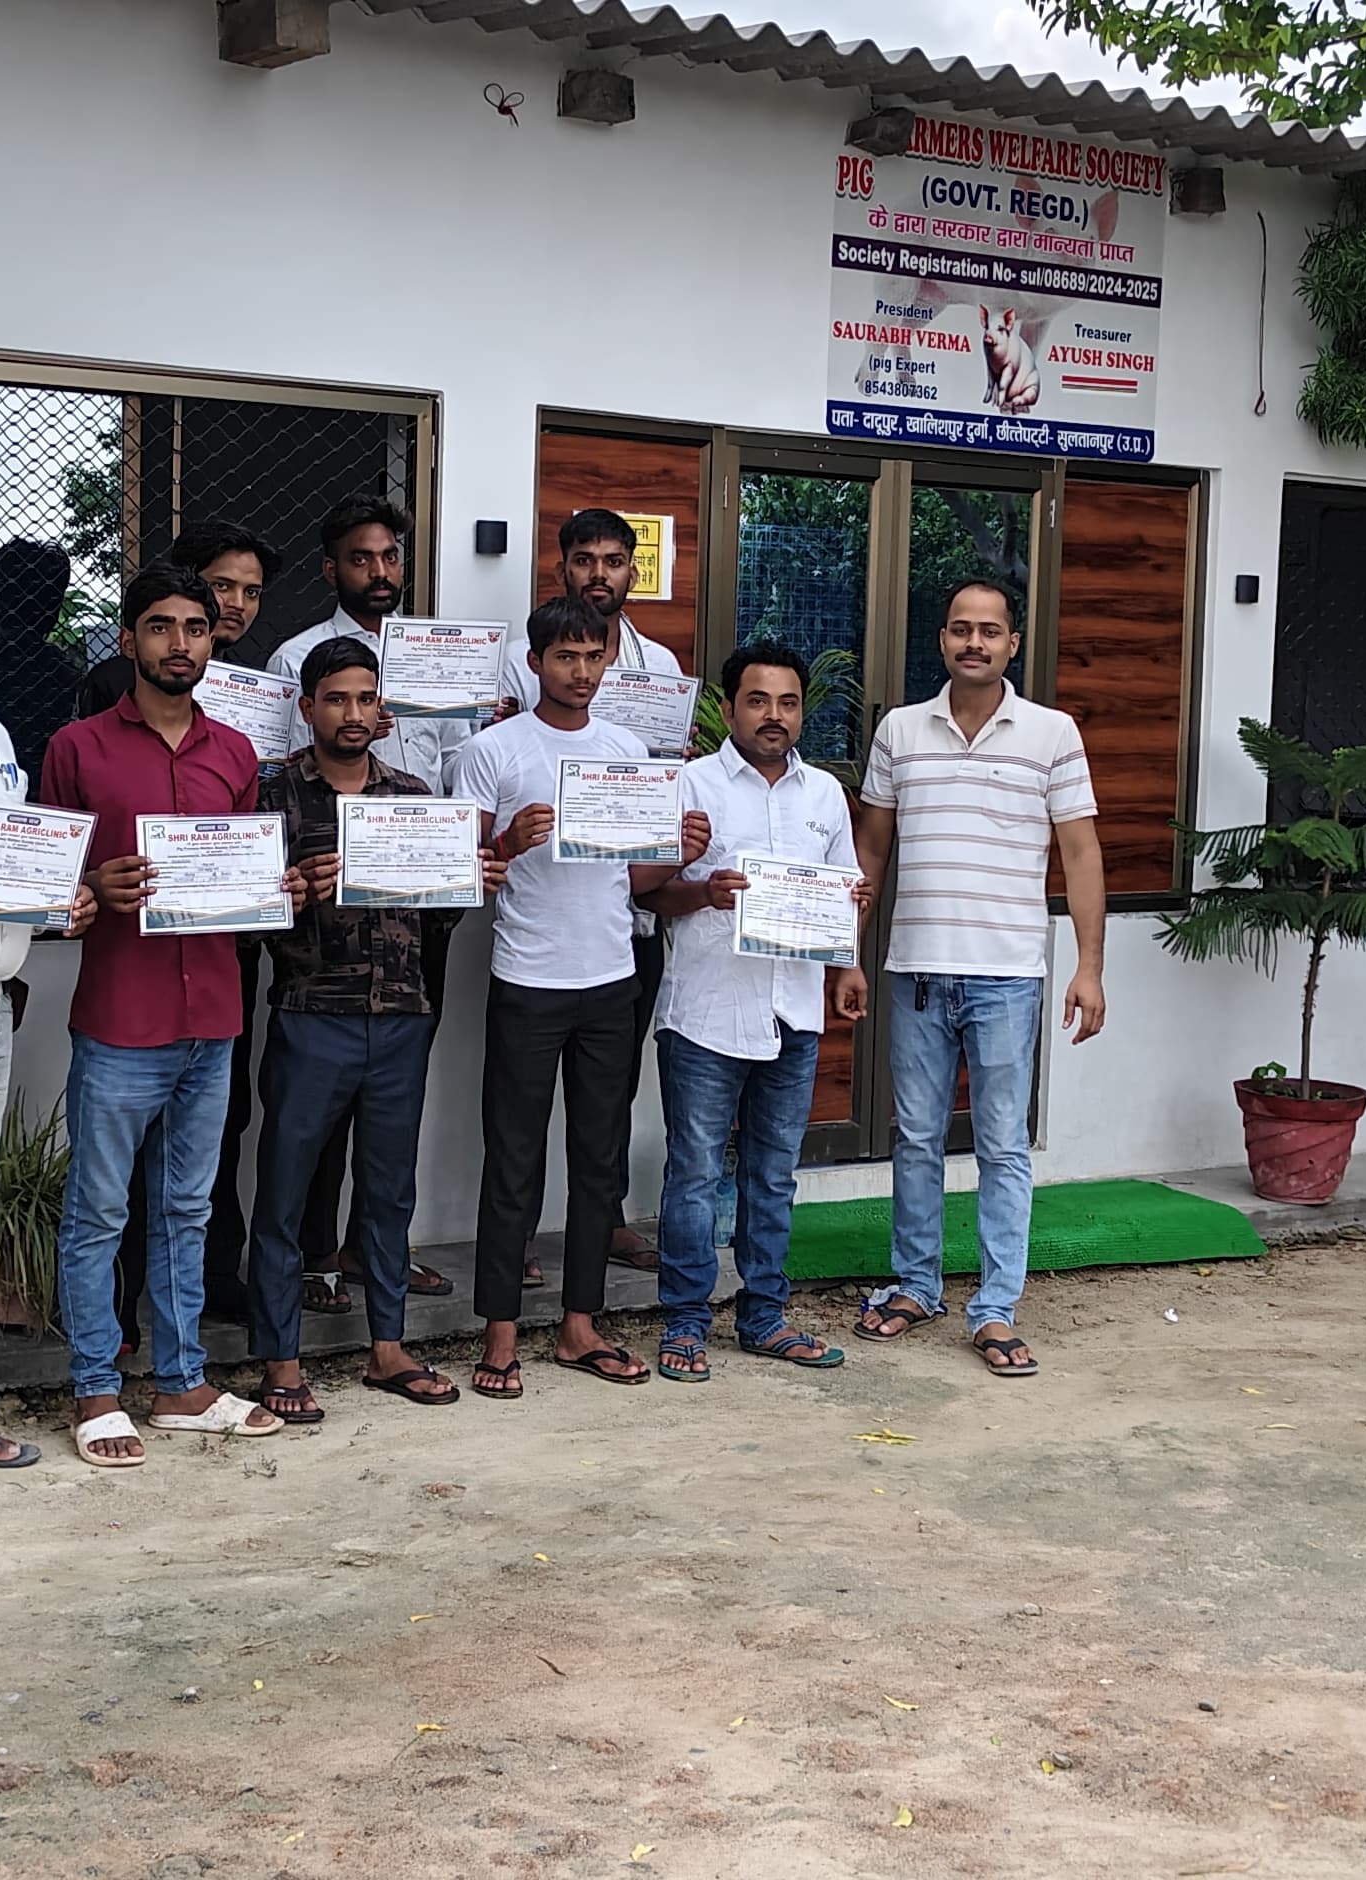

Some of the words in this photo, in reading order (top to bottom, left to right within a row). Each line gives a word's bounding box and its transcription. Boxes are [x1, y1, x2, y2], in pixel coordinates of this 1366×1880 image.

[906, 116, 984, 163] RMERS
[989, 129, 1082, 178] WELFARE
[1086, 145, 1166, 191] SOCIETY
[837, 155, 874, 195] PIG
[923, 176, 1001, 211] (GOVT.
[1010, 189, 1088, 231] REGD.)
[868, 204, 888, 228] के
[894, 213, 926, 234] द्वारा
[932, 219, 991, 243] सरकार
[996, 228, 1028, 248] द्वारा
[1034, 233, 1094, 257] मान्यता
[1099, 242, 1135, 263] प्राप्त
[838, 241, 895, 271] Society
[900, 249, 988, 278] Registration
[993, 262, 1016, 281] No-
[1020, 267, 1158, 300] sul/08689/2024-2025
[876, 300, 933, 320] President
[833, 321, 912, 345] SAURABH
[916, 330, 972, 352] VERMA
[1075, 324, 1132, 343] Treasurer
[869, 354, 891, 373] (pig
[896, 357, 935, 374] Expert
[1048, 345, 1102, 367] AYUSH
[1106, 352, 1154, 372] SINGH
[832, 409, 859, 427] पता-
[862, 412, 903, 436] दादूपुर,
[1057, 430, 1114, 453] सुलतानपुर
[405, 635, 423, 643] SHRI
[581, 773, 599, 781] SHRI
[0, 823, 18, 832] RAM
[21, 826, 67, 839] AGRICLINIC
[168, 834, 188, 842] SHRI
[191, 833, 210, 841] RAM
[211, 832, 260, 841] AGRICLINIC
